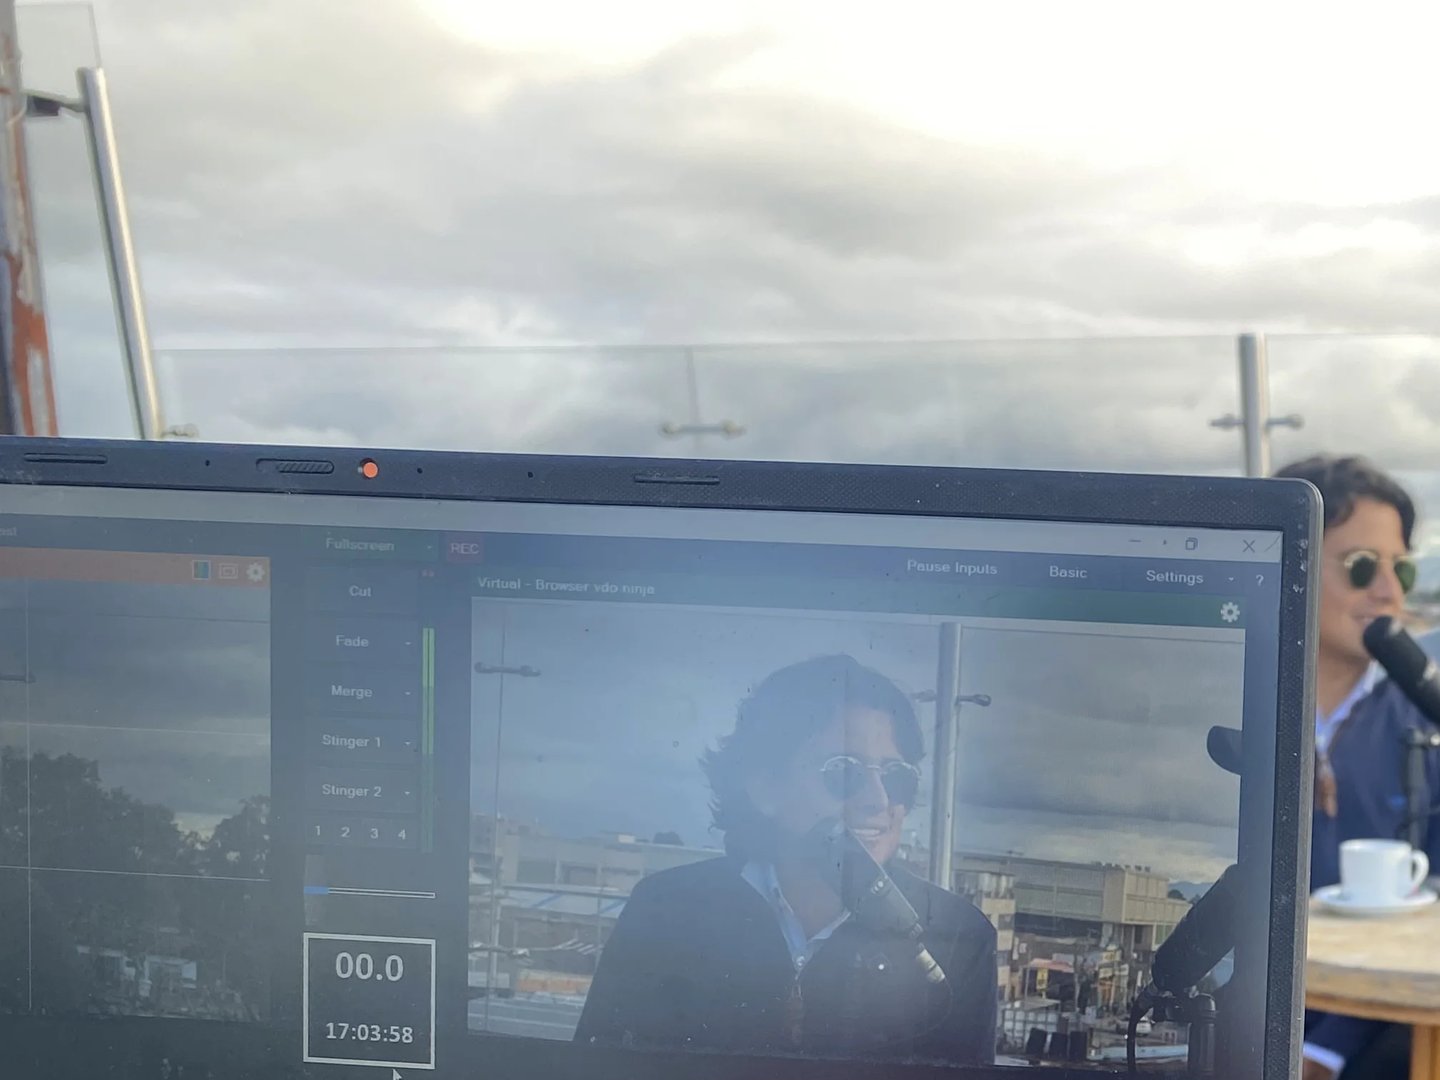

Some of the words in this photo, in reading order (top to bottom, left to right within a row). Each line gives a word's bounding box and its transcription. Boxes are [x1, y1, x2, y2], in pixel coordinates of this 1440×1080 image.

[325, 538, 395, 551] Fullscreen
[451, 543, 479, 554] REC
[907, 559, 950, 573] Pause
[955, 562, 998, 577] Inputs
[1049, 565, 1088, 579] Basic
[1146, 569, 1204, 585] Settings
[1255, 574, 1264, 587] ?
[349, 585, 372, 597] Cut
[478, 577, 521, 590] Virtual
[535, 579, 589, 593] Browser
[335, 635, 369, 648] Fade
[331, 685, 373, 699] Merge
[322, 734, 370, 749] Stinger
[375, 737, 382, 748] 1
[322, 783, 370, 799] Stinger
[373, 786, 383, 797] 2
[315, 825, 321, 836] 1
[341, 826, 350, 838] 2
[370, 828, 379, 839] 3
[398, 829, 407, 840] 4
[335, 952, 404, 981] 00.0
[325, 1022, 414, 1043] 17:03:58
